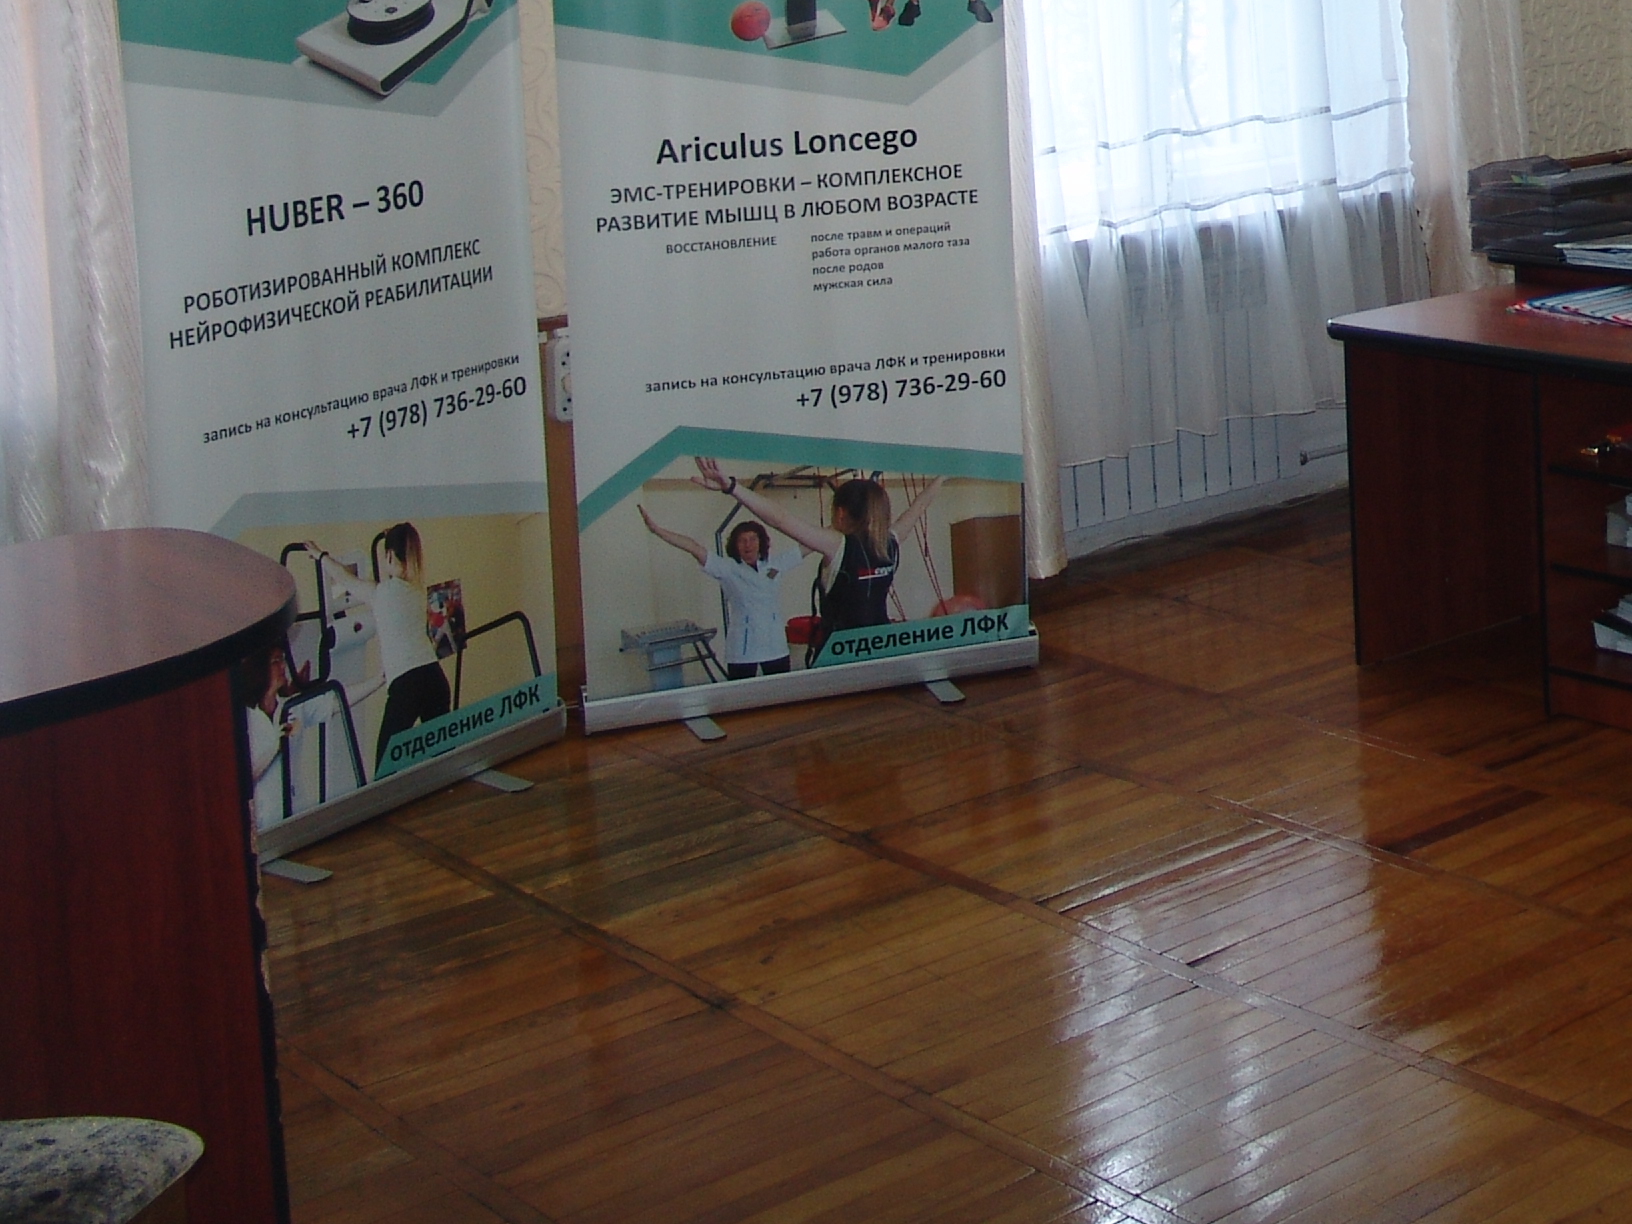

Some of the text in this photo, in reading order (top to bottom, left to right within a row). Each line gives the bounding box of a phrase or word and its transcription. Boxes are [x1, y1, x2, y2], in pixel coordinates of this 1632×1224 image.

[656, 129, 918, 165] Ariculus Loncego
[610, 176, 796, 204] ЭМС-ТРЕНИРОВКИ
[817, 163, 963, 189] КОМПЛЕКСНОЕ
[246, 193, 345, 237] HUBER
[376, 179, 424, 214] 360
[596, 189, 979, 233] РАЗВИТИЕ МЫШЦ В ЛЮБОМ ВОЗРАСТЕ
[666, 236, 778, 254] ВОССТАНОВЛЕНИЕ
[810, 222, 952, 243] после травм и операций
[811, 237, 970, 261] работа органов малого таза
[184, 238, 481, 314] РОБОТИЗИРОВАННЫЙ КОМПЛЕКС
[812, 261, 885, 275] после родов
[813, 277, 893, 292] мужская сила
[169, 265, 493, 350] НЕЙРОФИЗИЧЕСКОЙ РЕАБИЛИТАЦИИ
[645, 348, 1006, 393] запись на консультацию врача ЛФК и тренировки
[796, 369, 1007, 409] +7 (978) 736-29-60
[203, 354, 520, 444] запись на консультацию врача ЛФК и тренировки
[347, 376, 527, 439] +7 (978) 736-29-60
[831, 612, 1009, 657] отделение ЛФК
[390, 683, 540, 762] отделение ЛФК
